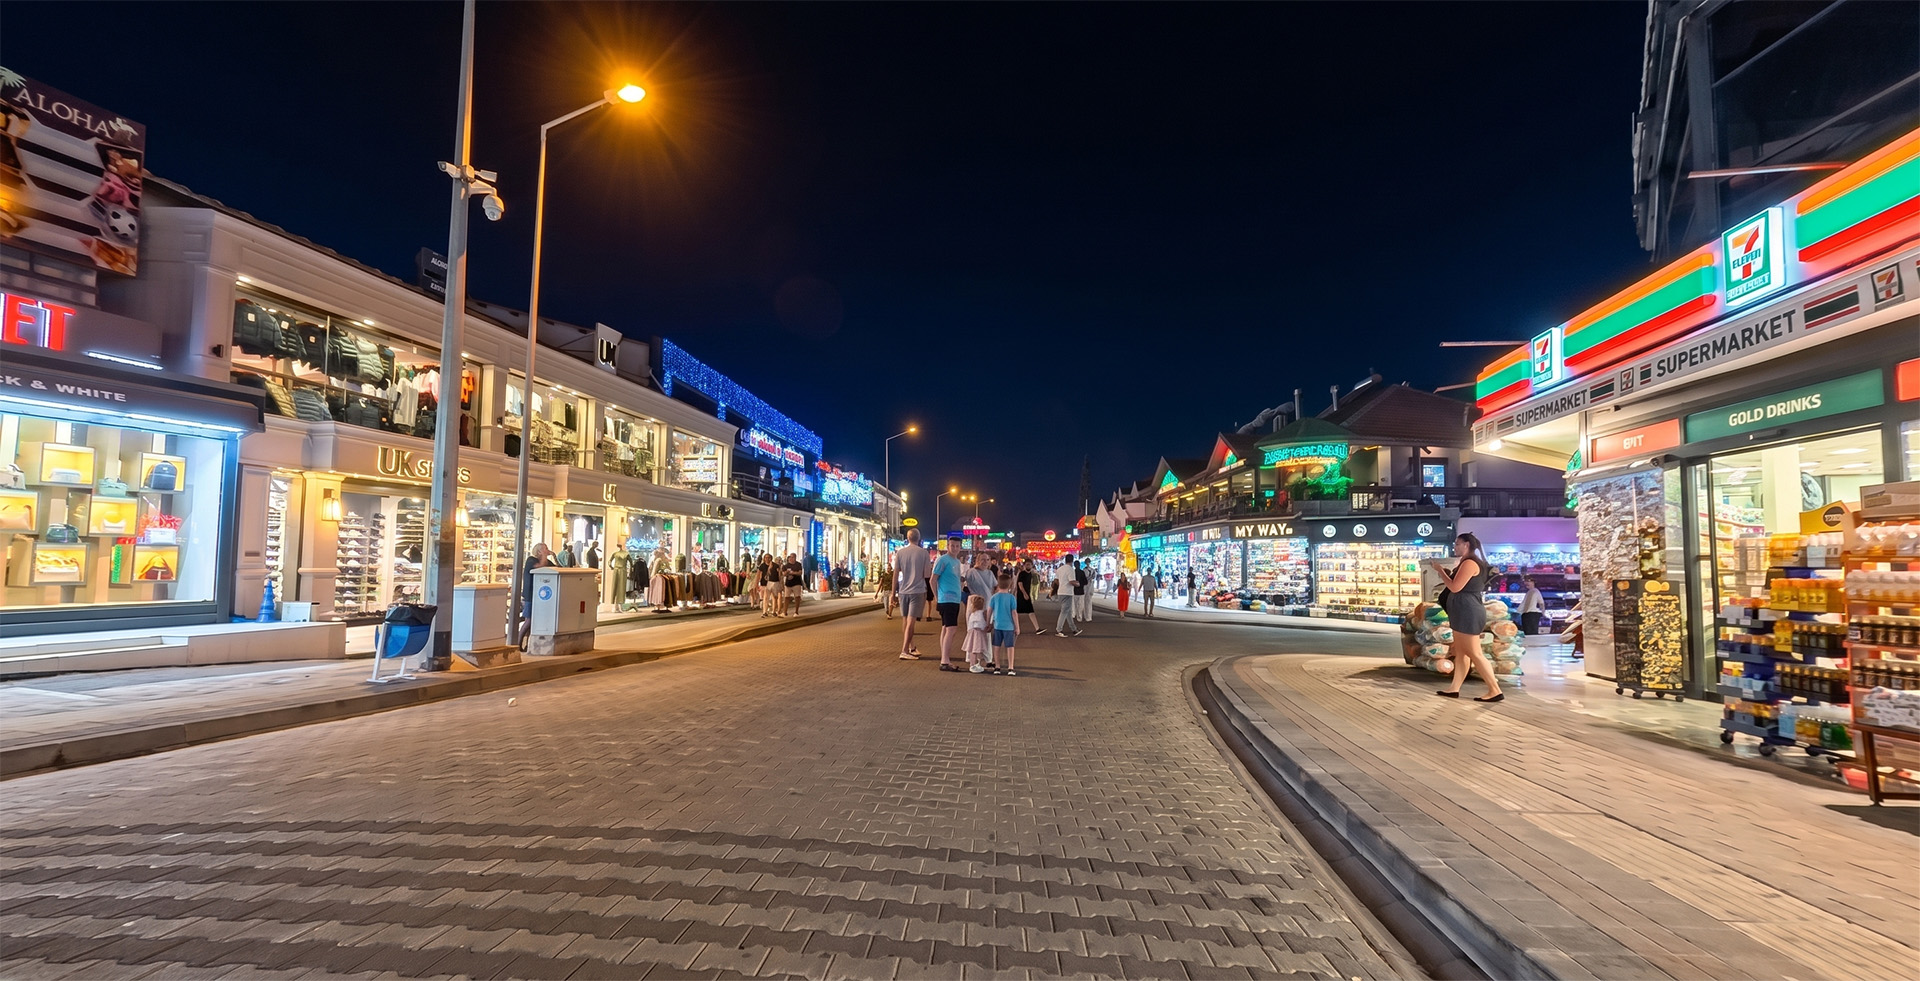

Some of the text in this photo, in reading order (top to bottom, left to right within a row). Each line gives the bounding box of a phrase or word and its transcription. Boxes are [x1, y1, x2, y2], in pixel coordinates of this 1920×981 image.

[14, 88, 112, 138] ALOHA
[1656, 309, 1796, 378] SUPERMARKET
[30, 379, 48, 390] &
[55, 383, 127, 402] WHITE
[1516, 389, 1588, 427] SUPERMARKET
[1728, 393, 1822, 427] GOLD DRINKS
[377, 446, 416, 478] UK
[1235, 525, 1255, 538] MY
[1257, 523, 1288, 537] WAY
